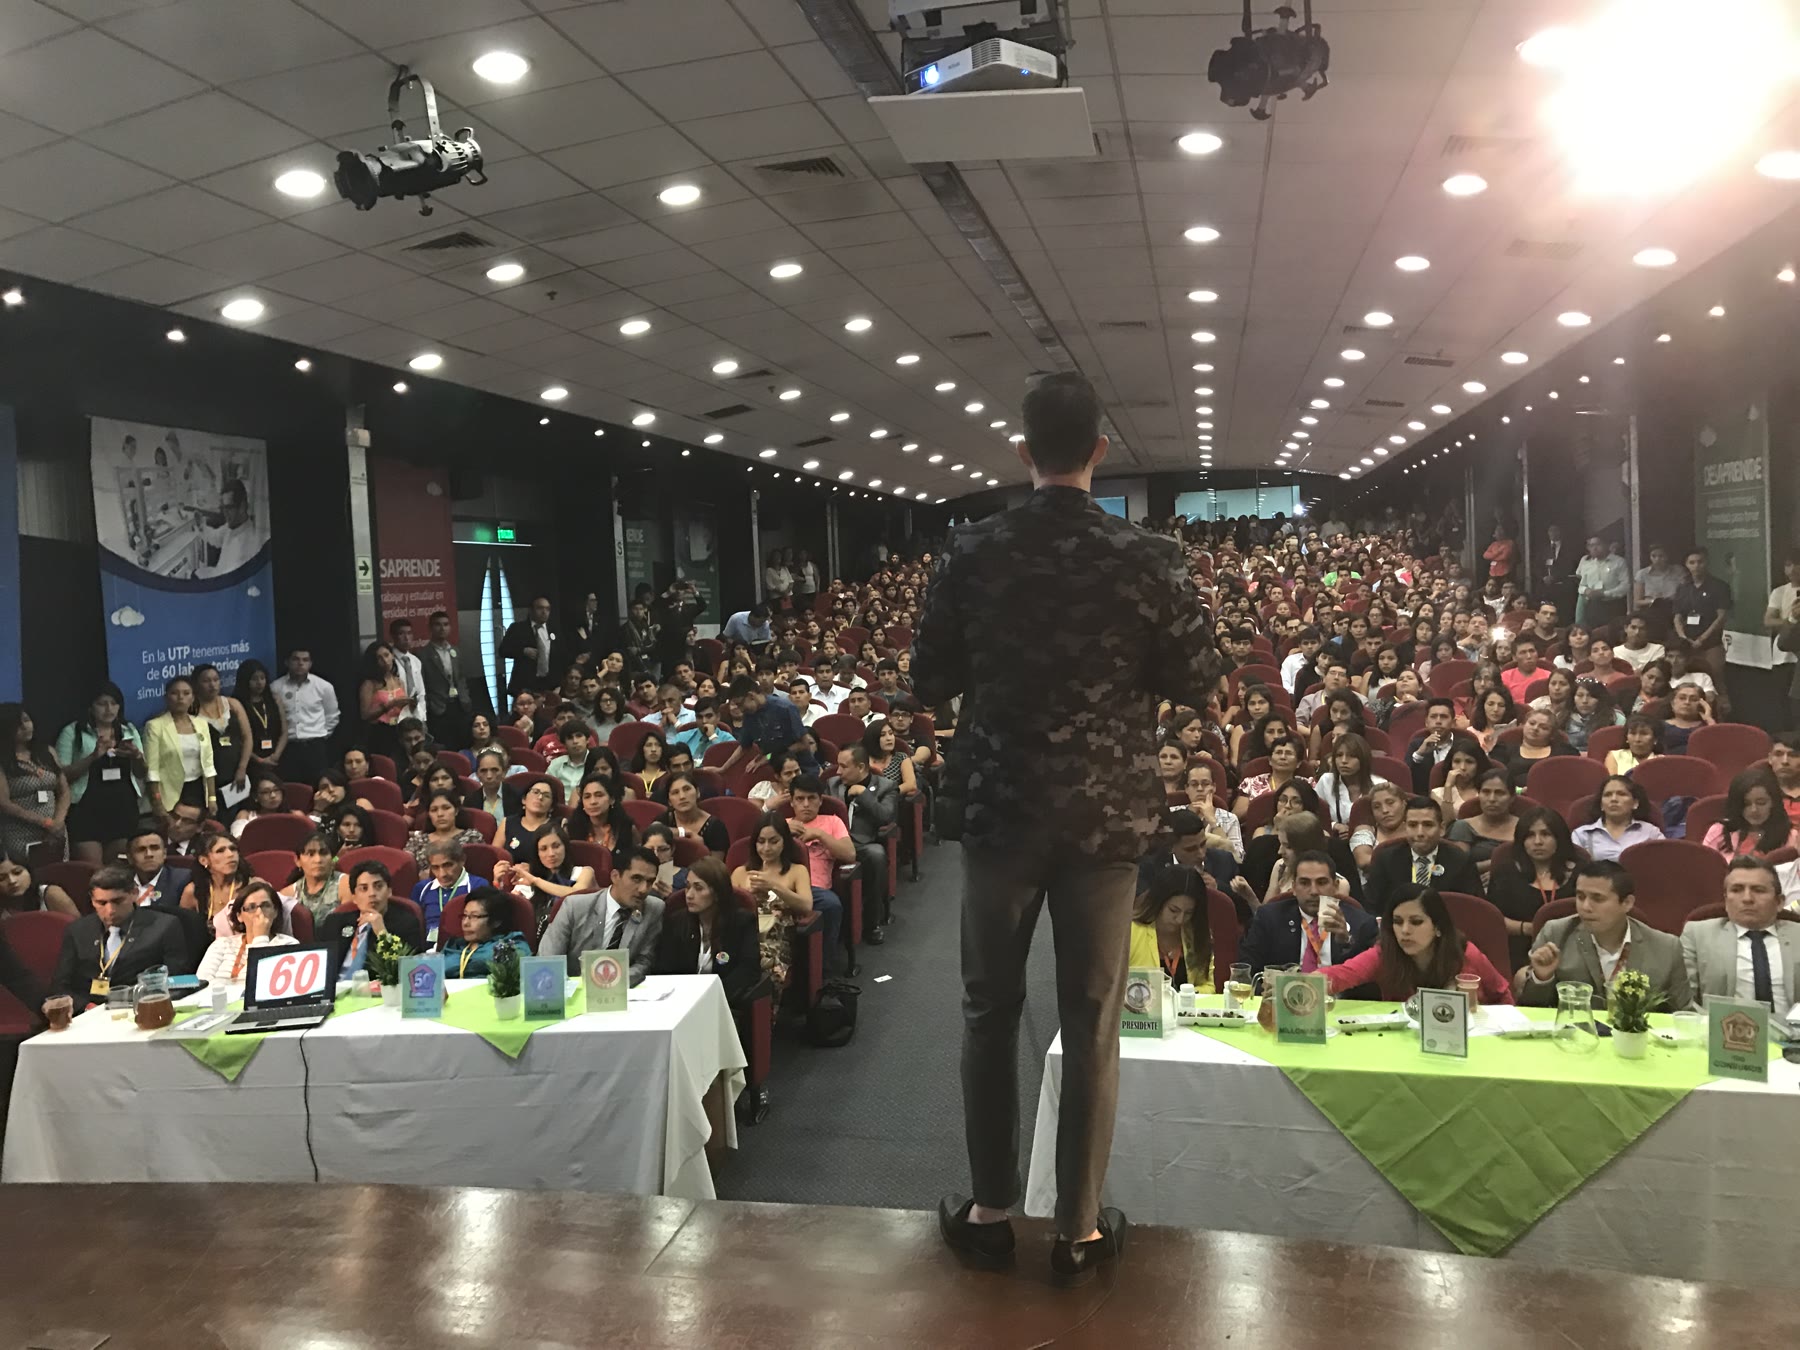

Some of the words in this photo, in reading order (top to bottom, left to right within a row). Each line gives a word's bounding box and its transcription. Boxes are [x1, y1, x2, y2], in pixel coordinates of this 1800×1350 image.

[379, 558, 441, 578] SAPRENDE
[142, 650, 155, 664] En
[157, 649, 166, 661] la
[167, 646, 191, 661] UTP
[192, 645, 230, 658] tenemos
[231, 640, 249, 653] más
[146, 668, 160, 681] de
[162, 664, 176, 679] 60
[137, 684, 166, 699] simul
[268, 952, 320, 997] 60
[1121, 1020, 1158, 1031] PRESIDENTE
